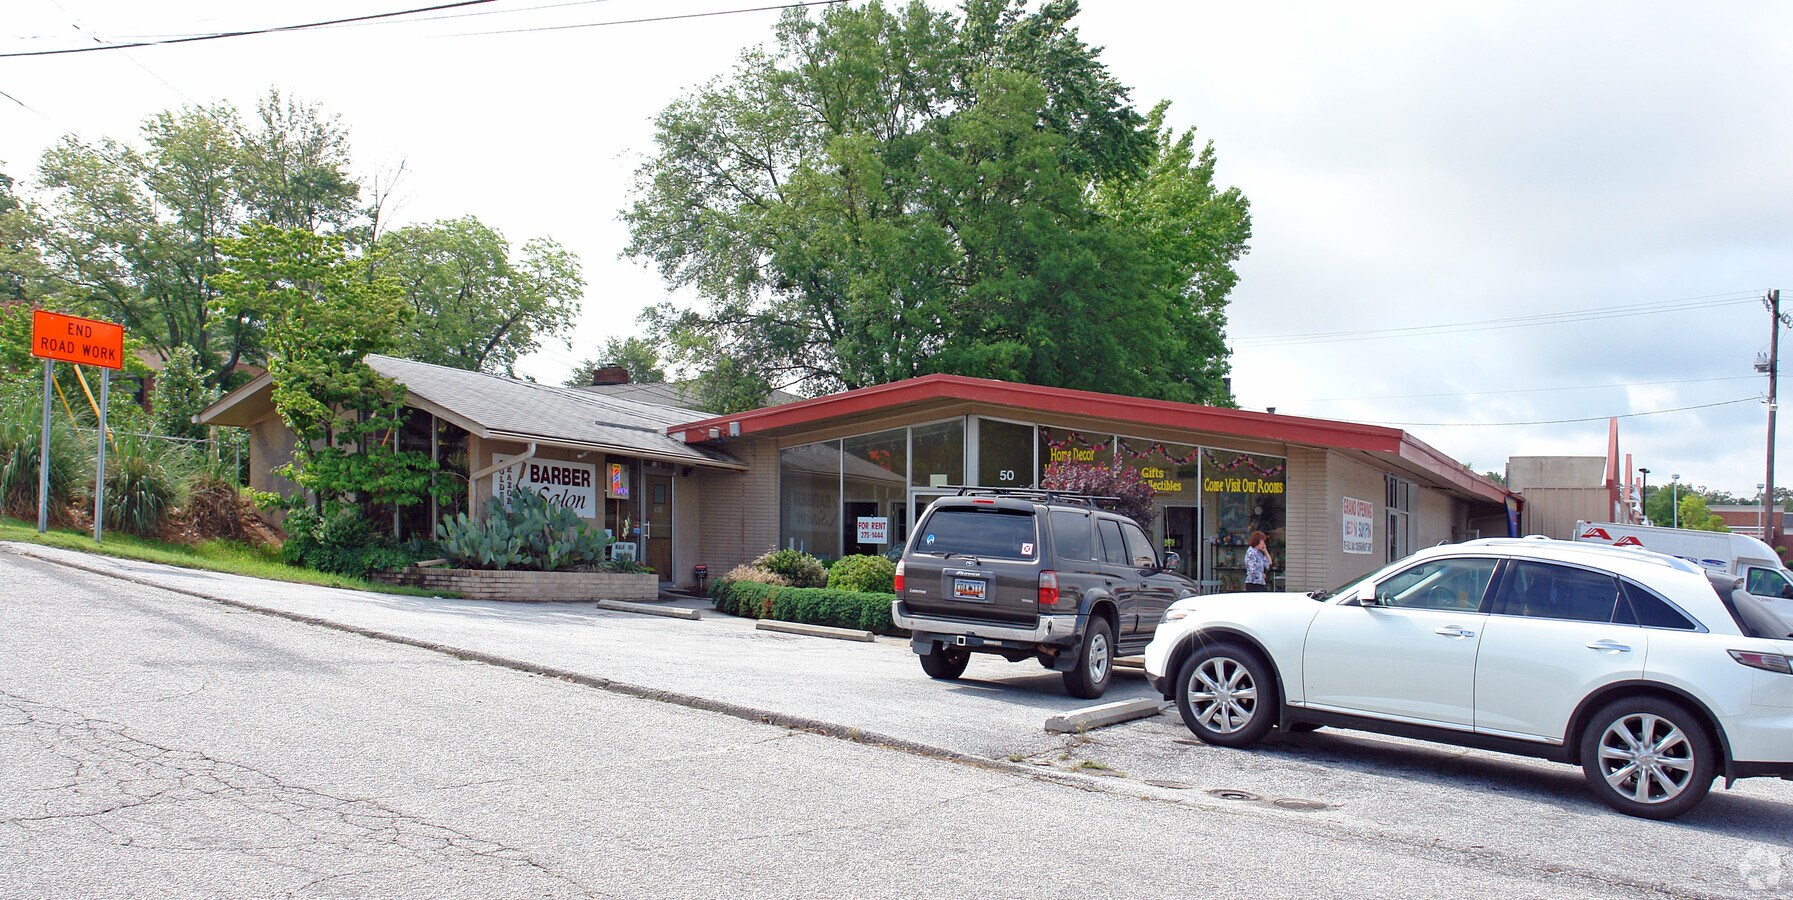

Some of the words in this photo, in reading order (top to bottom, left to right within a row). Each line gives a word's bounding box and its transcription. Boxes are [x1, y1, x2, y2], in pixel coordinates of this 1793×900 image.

[68, 322, 92, 338] END
[41, 337, 75, 354] ROAD
[82, 344, 115, 361] WORK
[1073, 448, 1095, 461] Decor
[530, 464, 591, 487] BARBER
[999, 470, 1015, 481] 50
[1141, 467, 1165, 478] Gifts
[1203, 477, 1224, 492] Come
[1225, 478, 1242, 493] Visit
[1242, 479, 1256, 493] Our
[1257, 479, 1284, 493] Rooms
[858, 522, 869, 530] FOR
[871, 522, 886, 530] RENT
[861, 531, 884, 539] 275-1444
